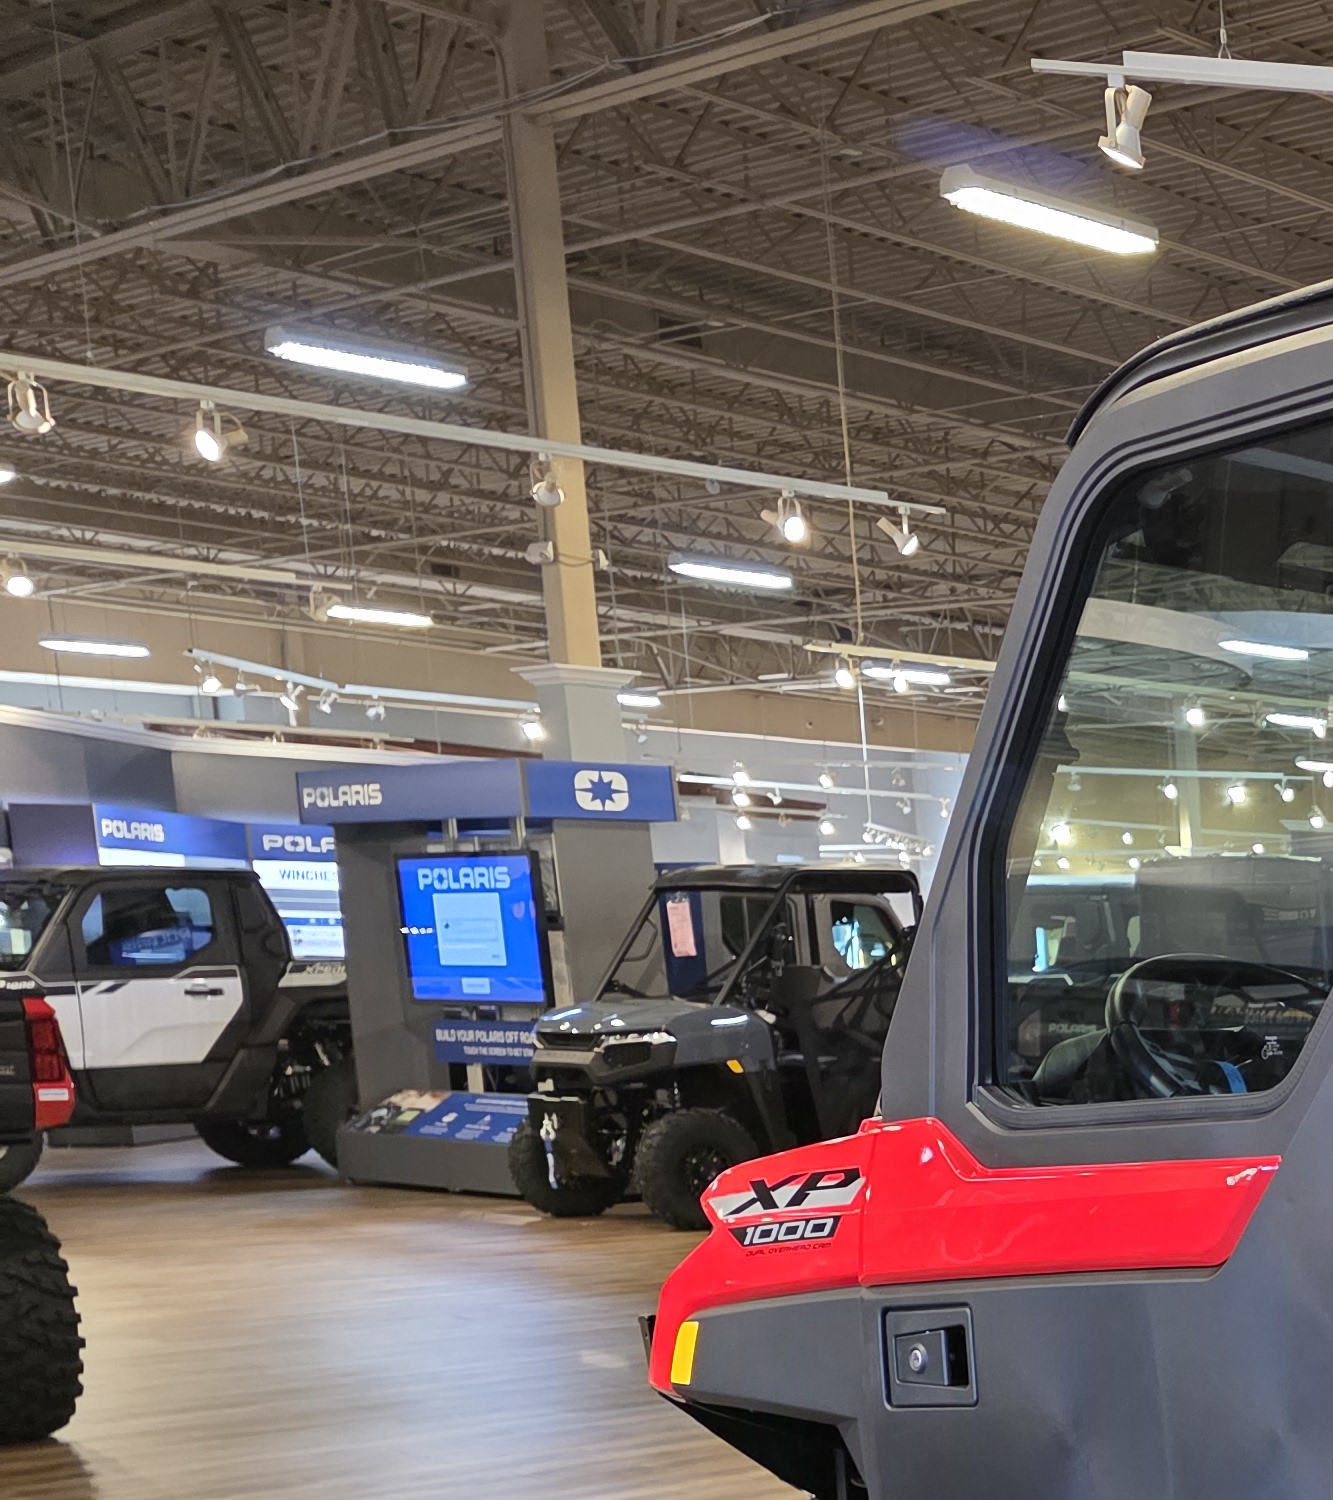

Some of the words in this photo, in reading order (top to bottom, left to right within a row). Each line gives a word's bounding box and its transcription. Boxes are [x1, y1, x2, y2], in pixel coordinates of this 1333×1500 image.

[303, 783, 383, 809] POLARIS
[101, 818, 165, 843] POLARIS
[417, 866, 511, 891] POLARIS
[457, 1029, 474, 1043] YOUR
[475, 1029, 504, 1043] POLARIS
[724, 1167, 862, 1216] XP
[743, 1217, 834, 1245] 1000
